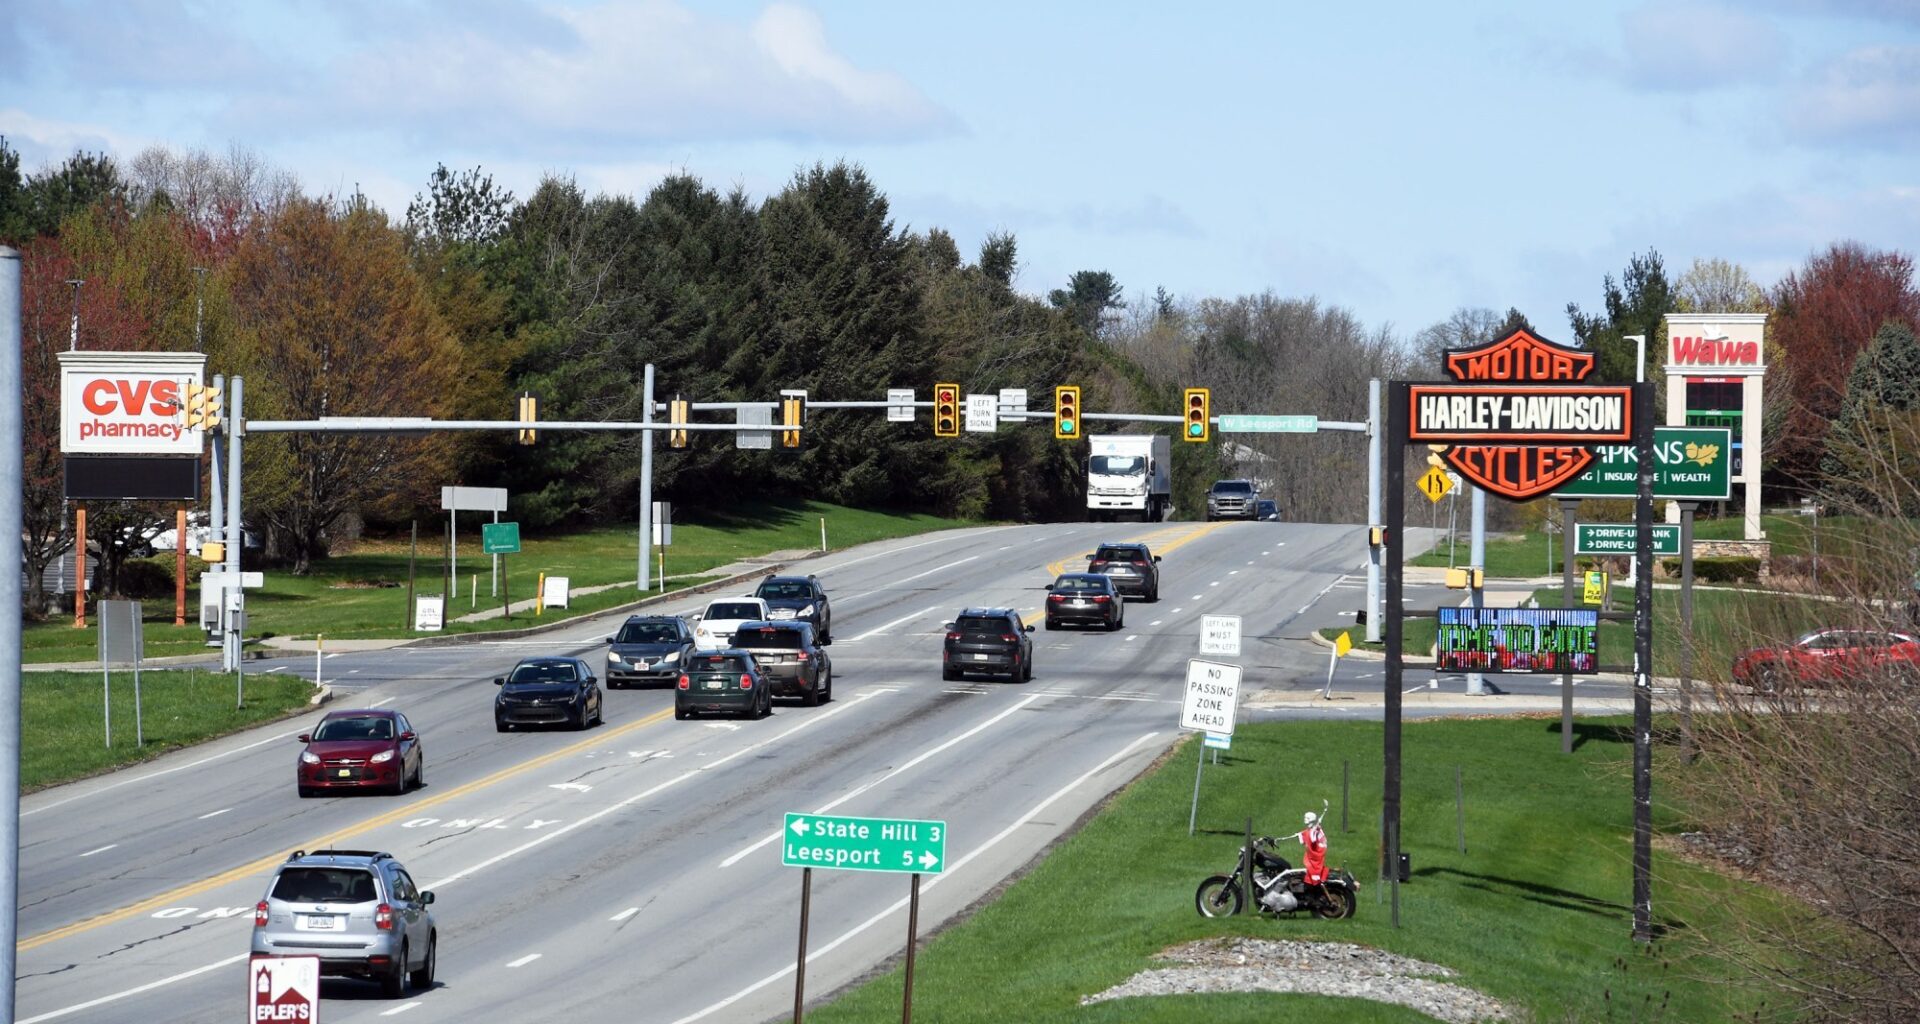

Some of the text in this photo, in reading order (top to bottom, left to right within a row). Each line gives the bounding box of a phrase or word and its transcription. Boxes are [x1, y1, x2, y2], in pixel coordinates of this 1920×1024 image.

[1673, 336, 1758, 365] Wawa
[1468, 338, 1574, 380] MOTOR
[82, 379, 180, 416] CVS
[1420, 396, 1621, 430] HARLEY-DAVIDSON
[80, 418, 184, 441] pharmacy
[1224, 418, 1313, 430] W Leesport Rd
[1464, 447, 1574, 490] CYCLES
[1671, 472, 1711, 482] WEALTH
[1595, 529, 1637, 538] DRIVE-U
[1595, 540, 1637, 549] DRIVE-U
[1205, 620, 1220, 628] LEFT
[1210, 631, 1231, 639] MUST
[1204, 642, 1237, 651] TURN LEFT
[1208, 669, 1221, 680] NO
[1190, 682, 1233, 697] PASSING
[1196, 698, 1223, 711] ZONE
[1192, 713, 1225, 727] AHEAD
[400, 817, 562, 829] ONLY
[814, 821, 941, 842] State Hill 3
[787, 844, 914, 866] Leesport 5
[257, 1004, 309, 1020] EPLER'S
